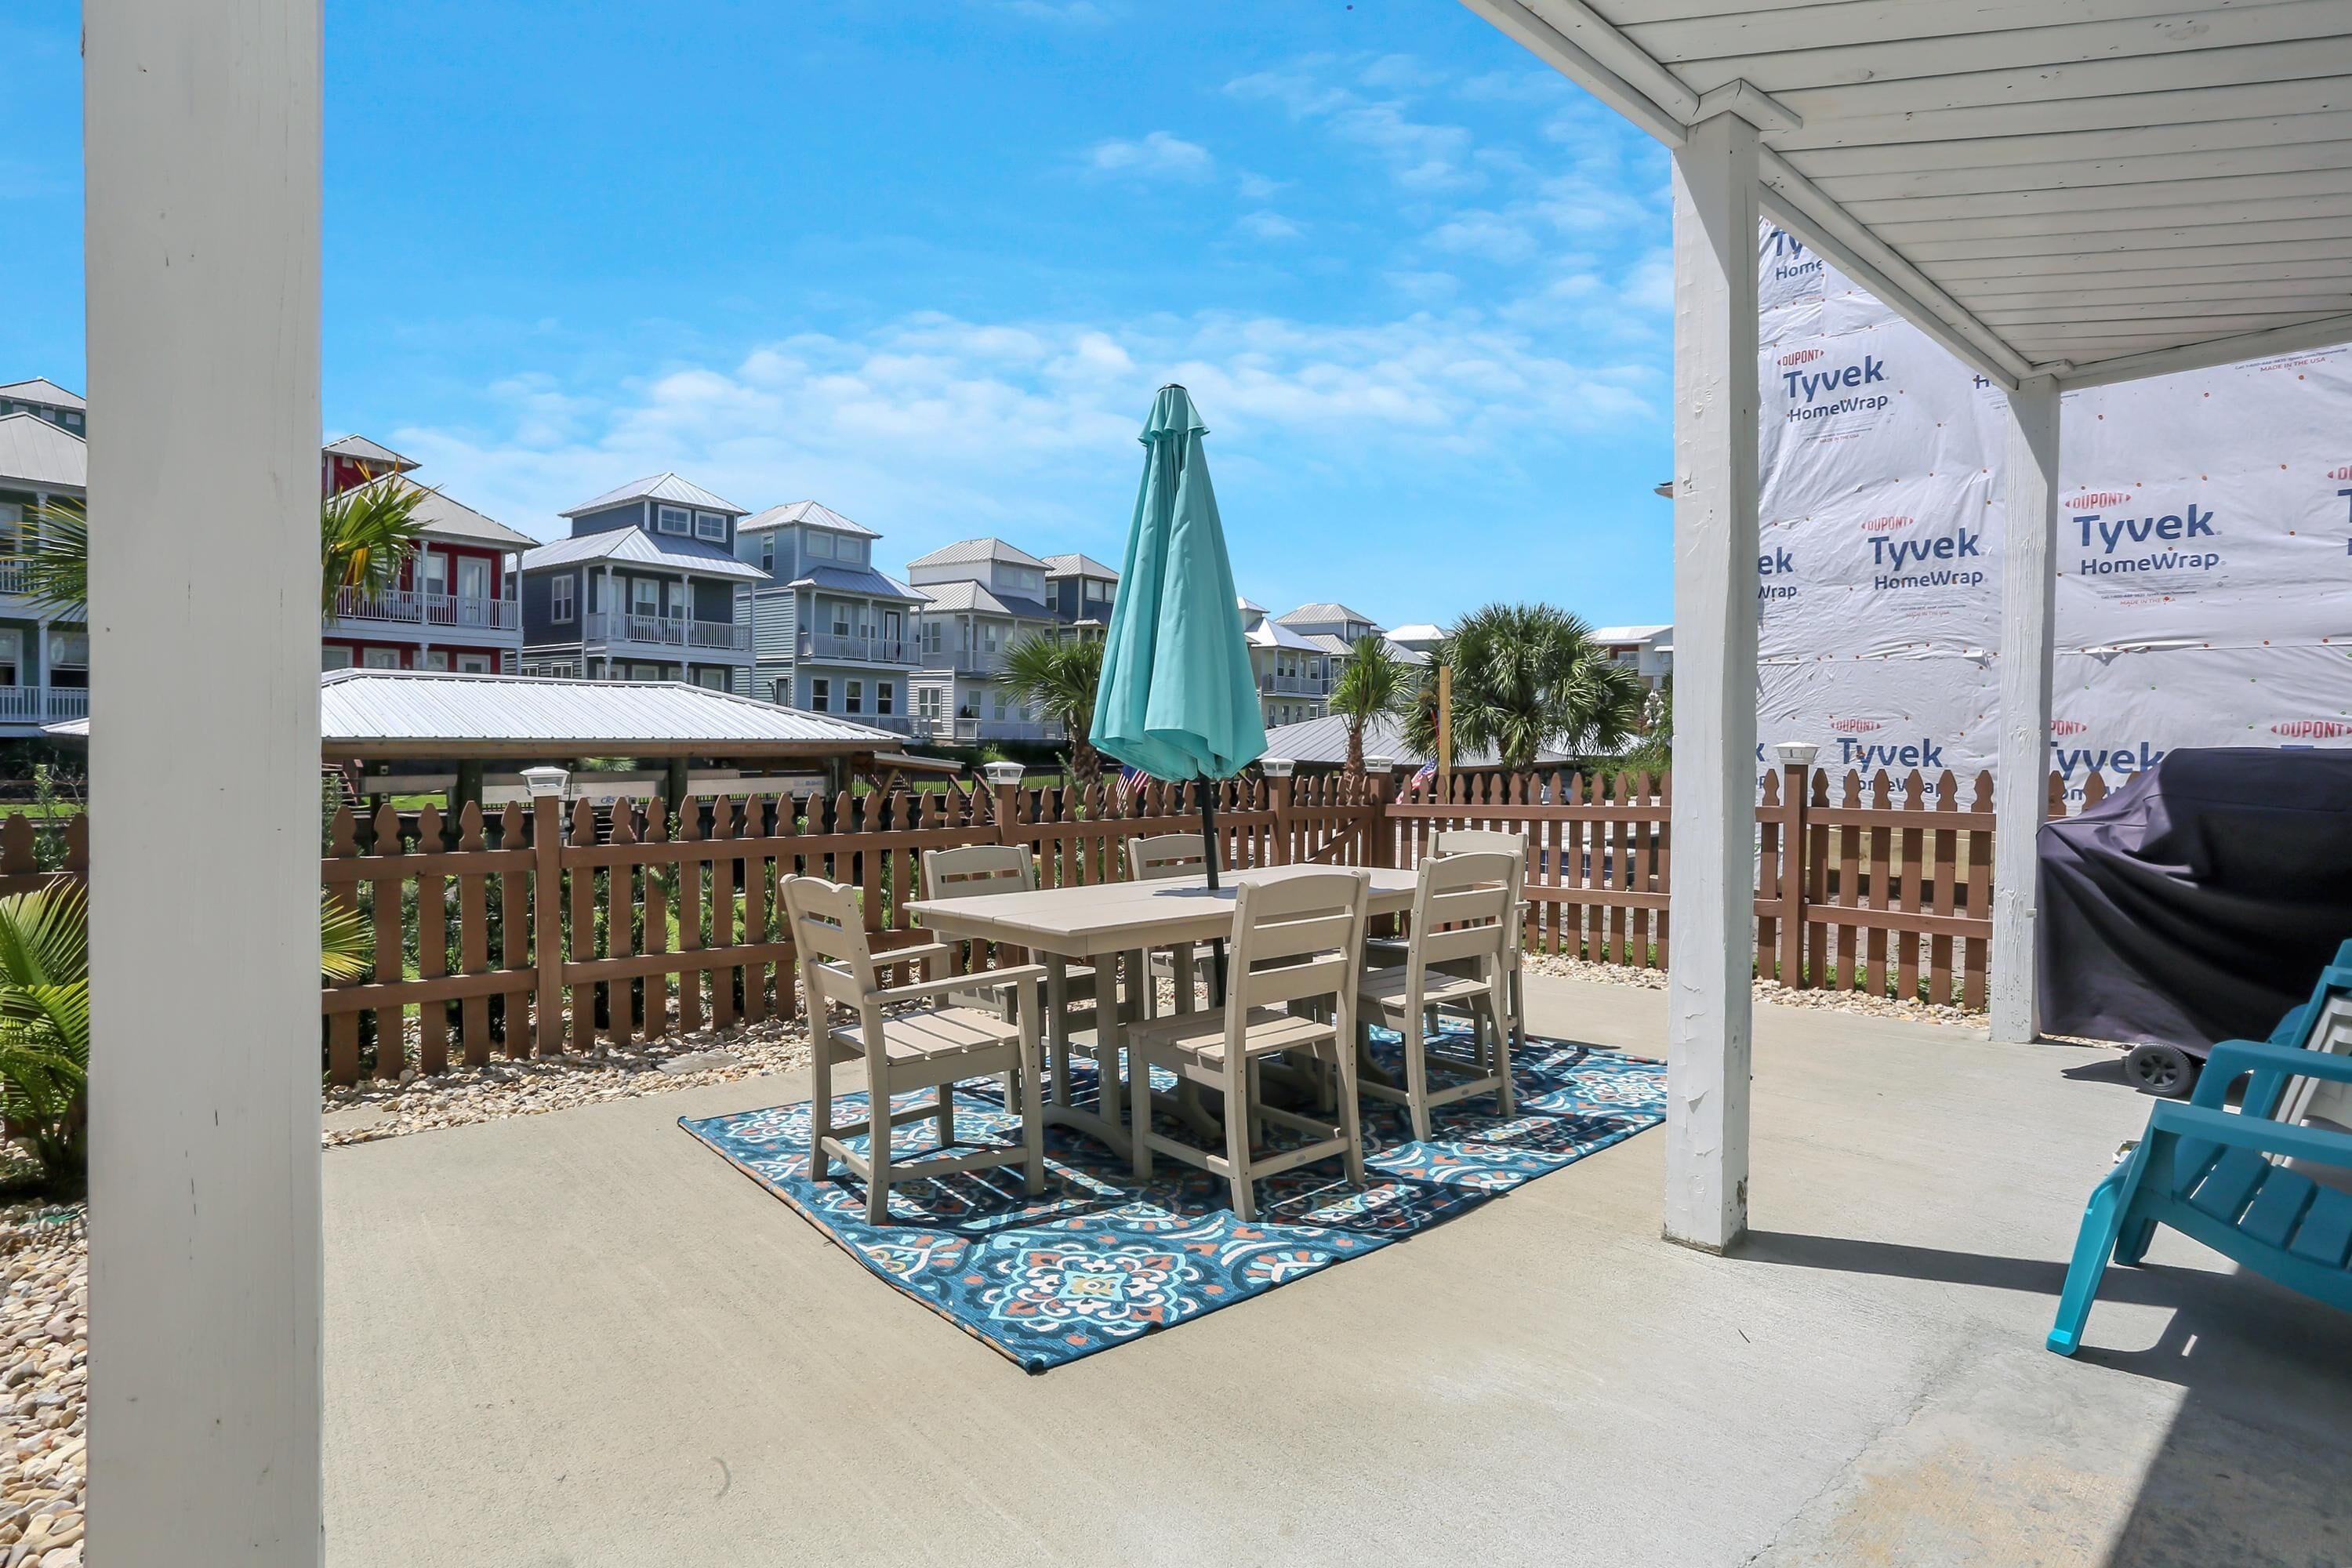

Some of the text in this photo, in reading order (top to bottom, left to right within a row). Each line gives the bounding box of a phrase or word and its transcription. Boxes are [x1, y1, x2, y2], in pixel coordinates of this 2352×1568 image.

[1776, 260, 1823, 281] Home
[1782, 349, 1820, 366] DUPONT
[2260, 363, 2282, 372] MADE
[1783, 355, 1884, 403] Tyvek
[1789, 396, 1889, 423] HomeWrap
[2072, 492, 2124, 510] DUPONT
[1867, 516, 1907, 531] DUPONT
[2073, 503, 2215, 554] Tyvek
[1867, 528, 1979, 572] Tyvek
[2081, 552, 2220, 575] HomeWrap
[1875, 570, 1984, 590] HomeWrap
[1758, 585, 1797, 600] Wrap
[2051, 720, 2082, 735] PONT
[2281, 720, 2344, 739] DUPONT
[1837, 737, 1943, 773] Tyvek
